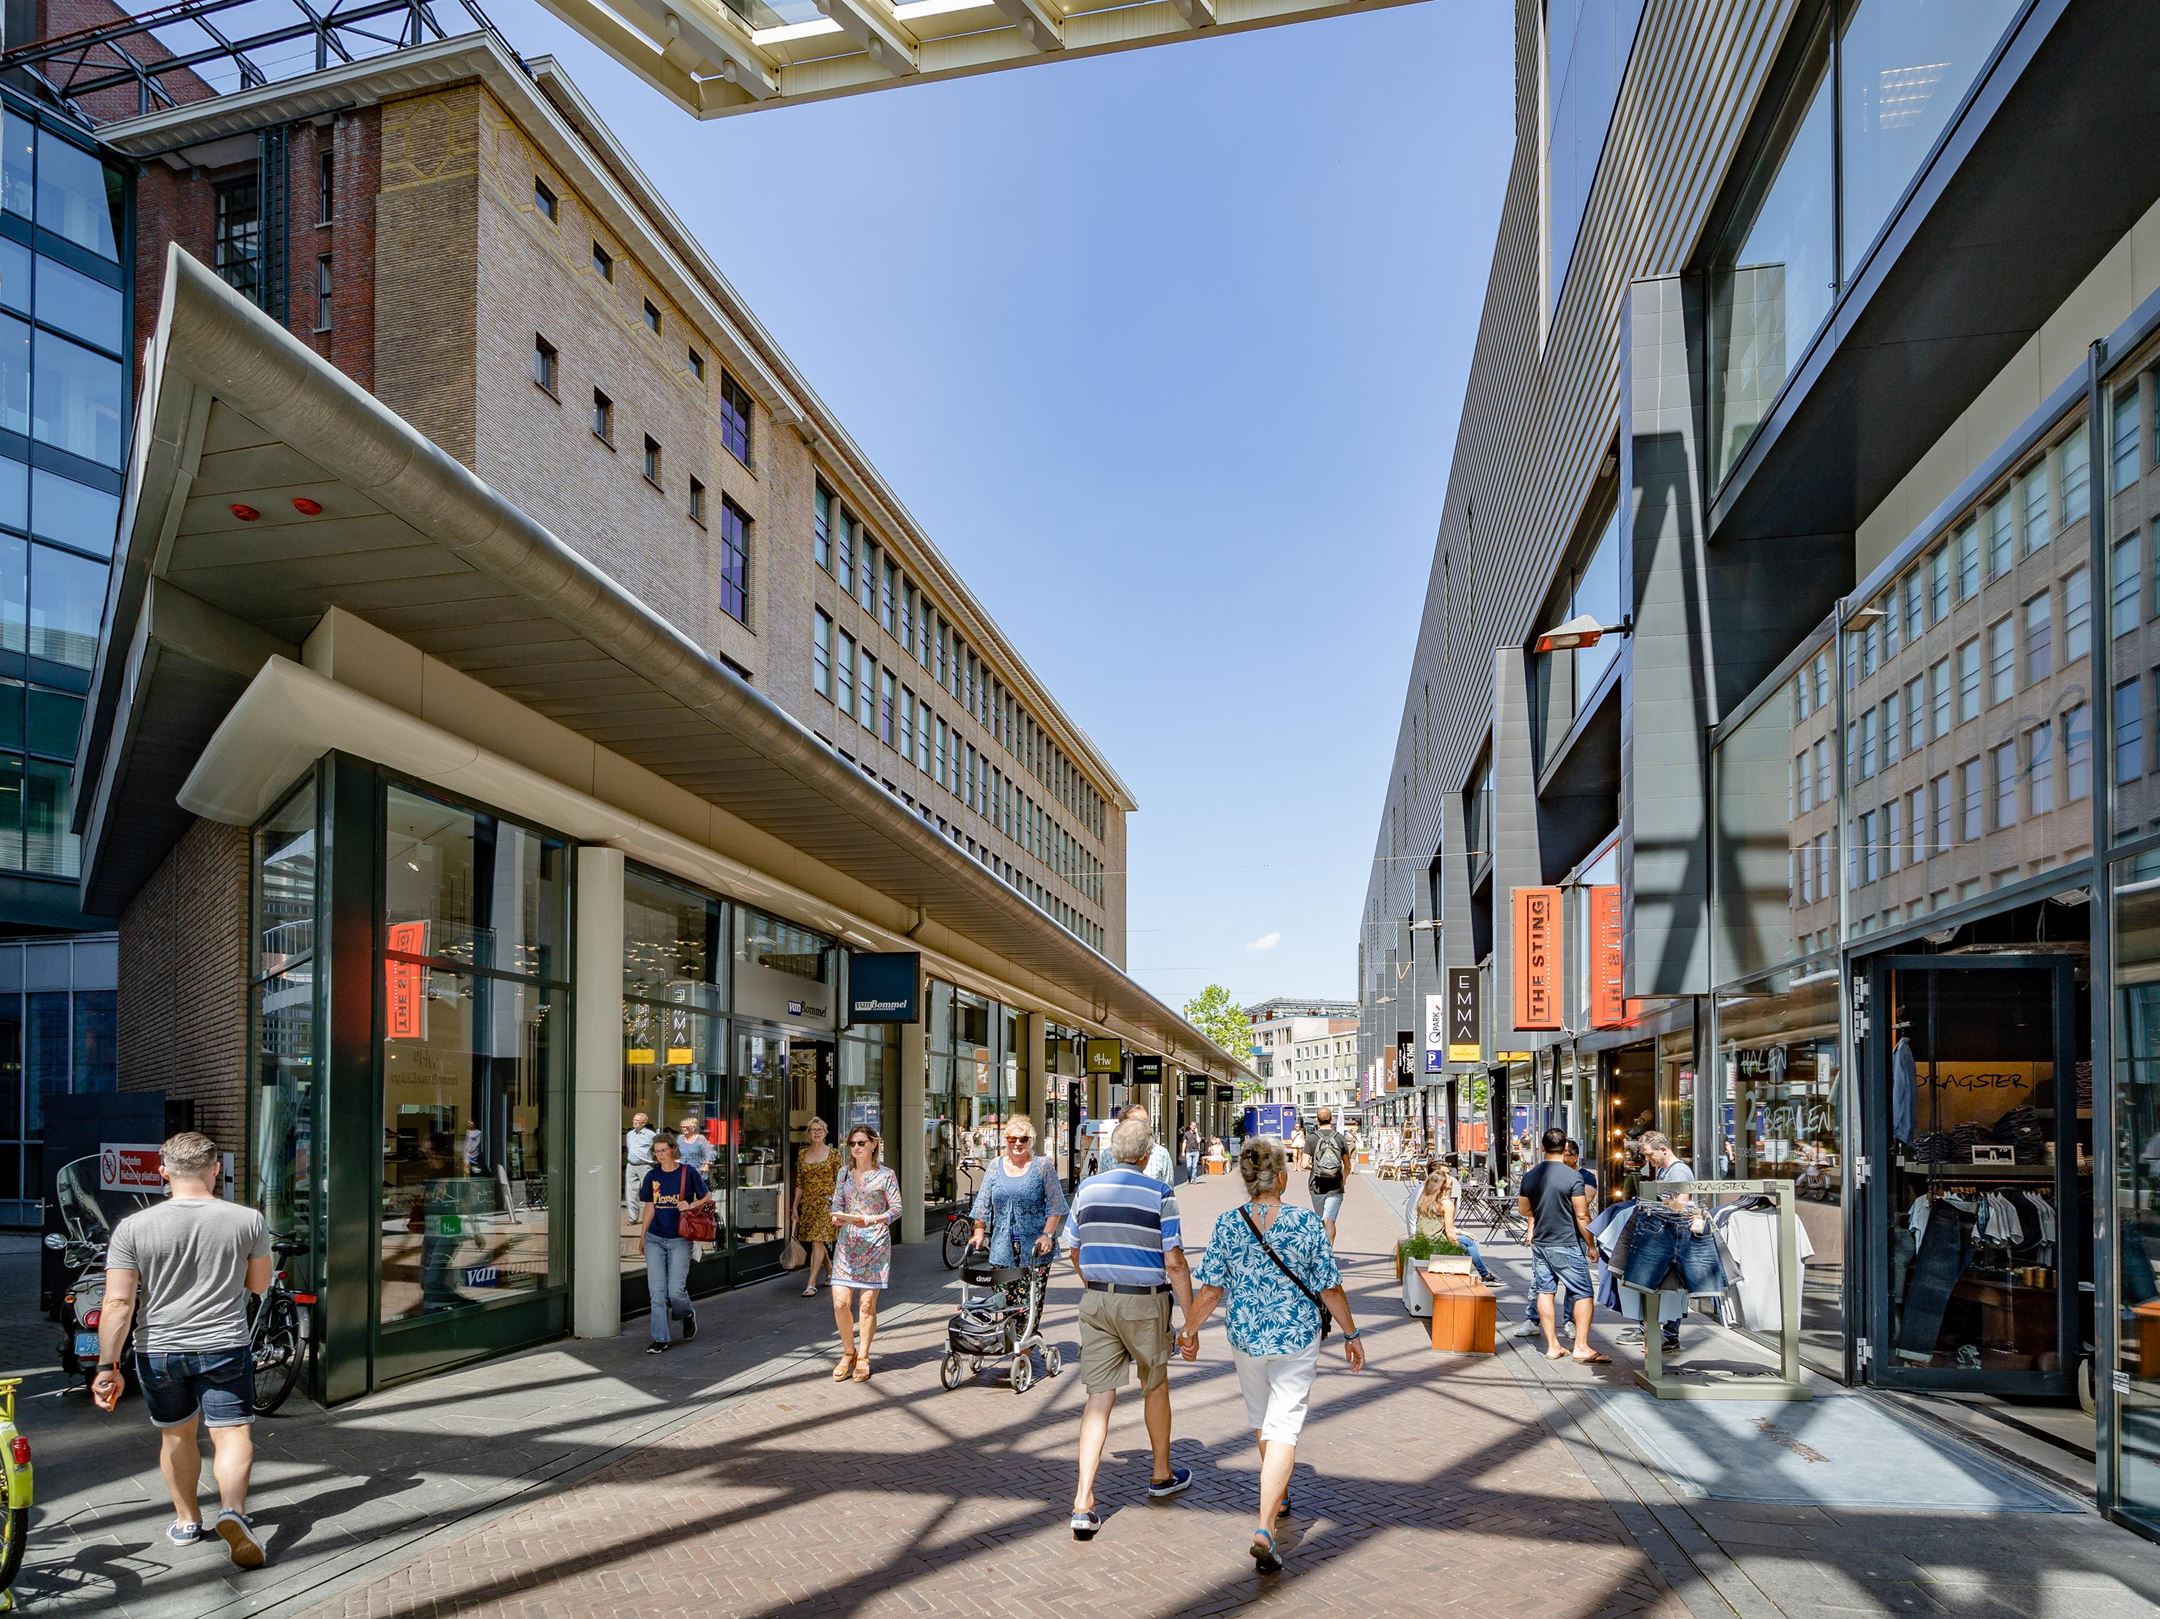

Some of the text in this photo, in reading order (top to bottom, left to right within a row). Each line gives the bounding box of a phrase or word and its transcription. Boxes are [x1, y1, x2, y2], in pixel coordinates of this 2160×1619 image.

[1532, 900, 1545, 1016] THE STING
[1457, 975, 1472, 1038] EMMA
[1427, 1053, 1437, 1065] P
[1745, 1091, 1757, 1131] 2
[1687, 1181, 1750, 1192] DRAGSTER
[466, 1265, 497, 1287] van
